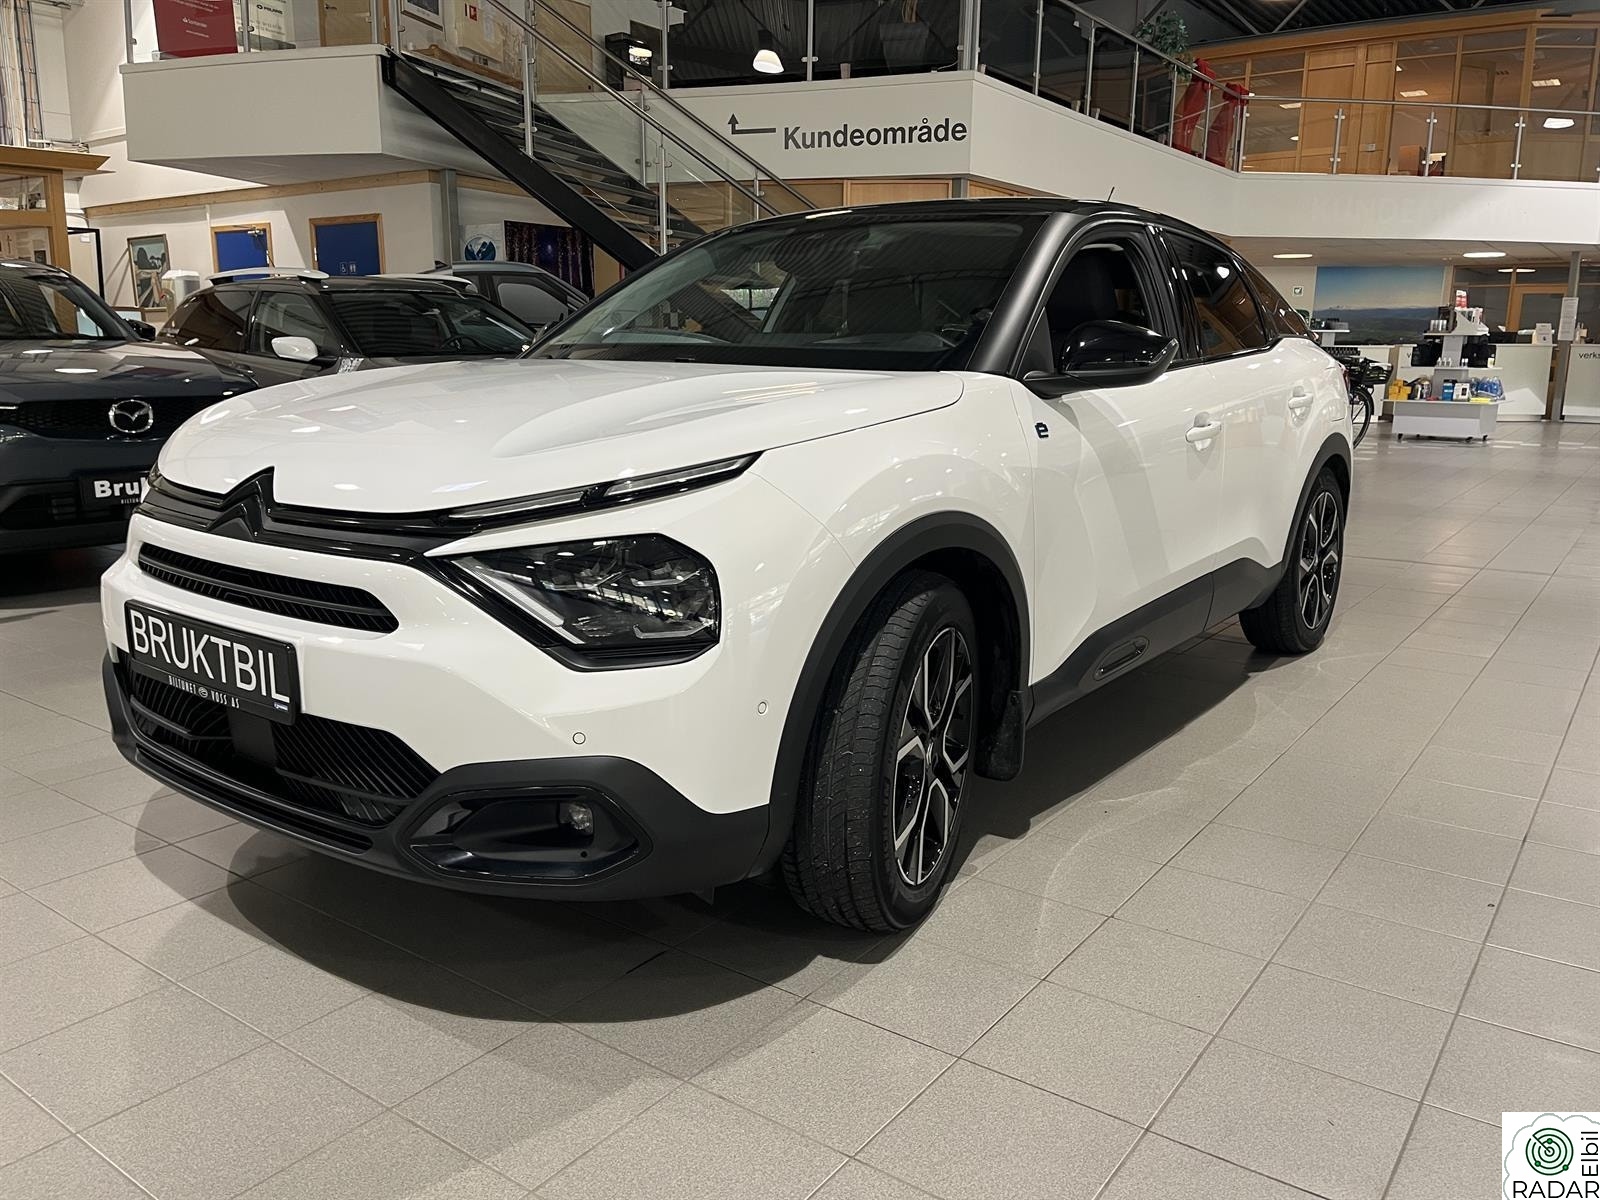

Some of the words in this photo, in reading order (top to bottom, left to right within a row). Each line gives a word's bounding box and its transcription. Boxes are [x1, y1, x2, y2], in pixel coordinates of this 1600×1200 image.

[784, 117, 967, 150] Kundeområde
[129, 608, 290, 704] BRUKTBIL
[210, 690, 228, 705] VOSS
[231, 697, 240, 709] AS
